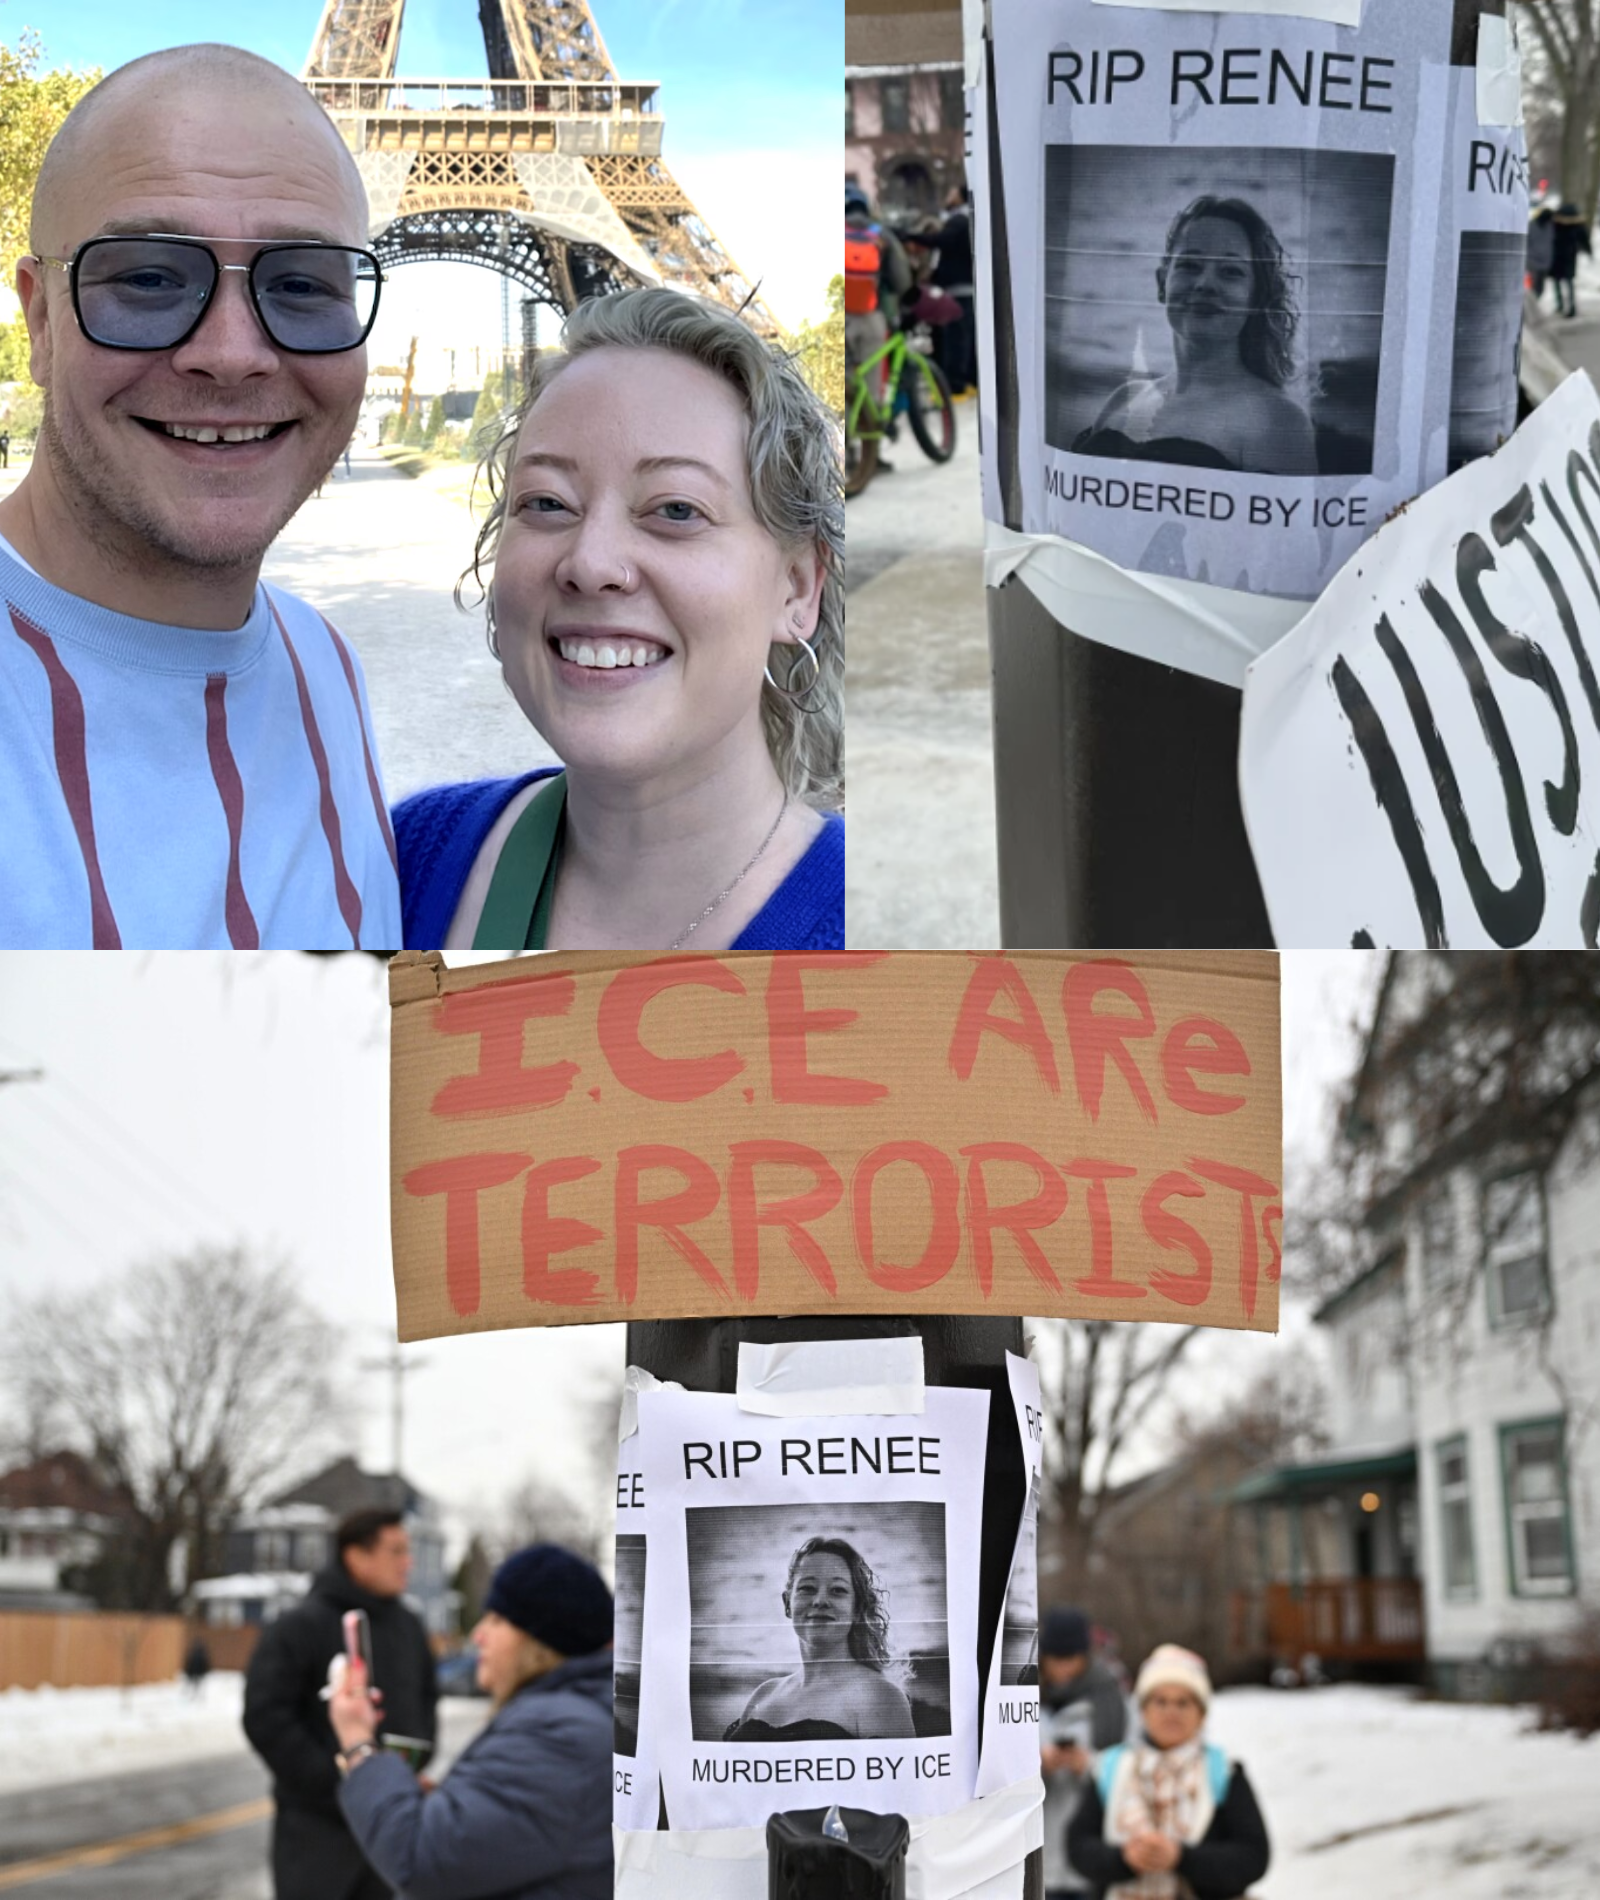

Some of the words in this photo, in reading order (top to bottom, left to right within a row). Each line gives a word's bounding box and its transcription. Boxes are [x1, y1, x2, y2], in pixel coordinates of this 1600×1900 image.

[1047, 50, 1145, 105] RIP
[1170, 49, 1396, 114] RENEE
[1044, 465, 1236, 521] MURDERED
[1249, 495, 1301, 528] BY
[1312, 497, 1369, 528] ICE
[402, 1138, 1284, 1322] TERRORISTS
[683, 1440, 763, 1480] RIP
[780, 1436, 942, 1476] RENEE
[692, 1757, 857, 1783] MURDERED
[866, 1756, 904, 1780] BY
[914, 1753, 951, 1779] ICE
